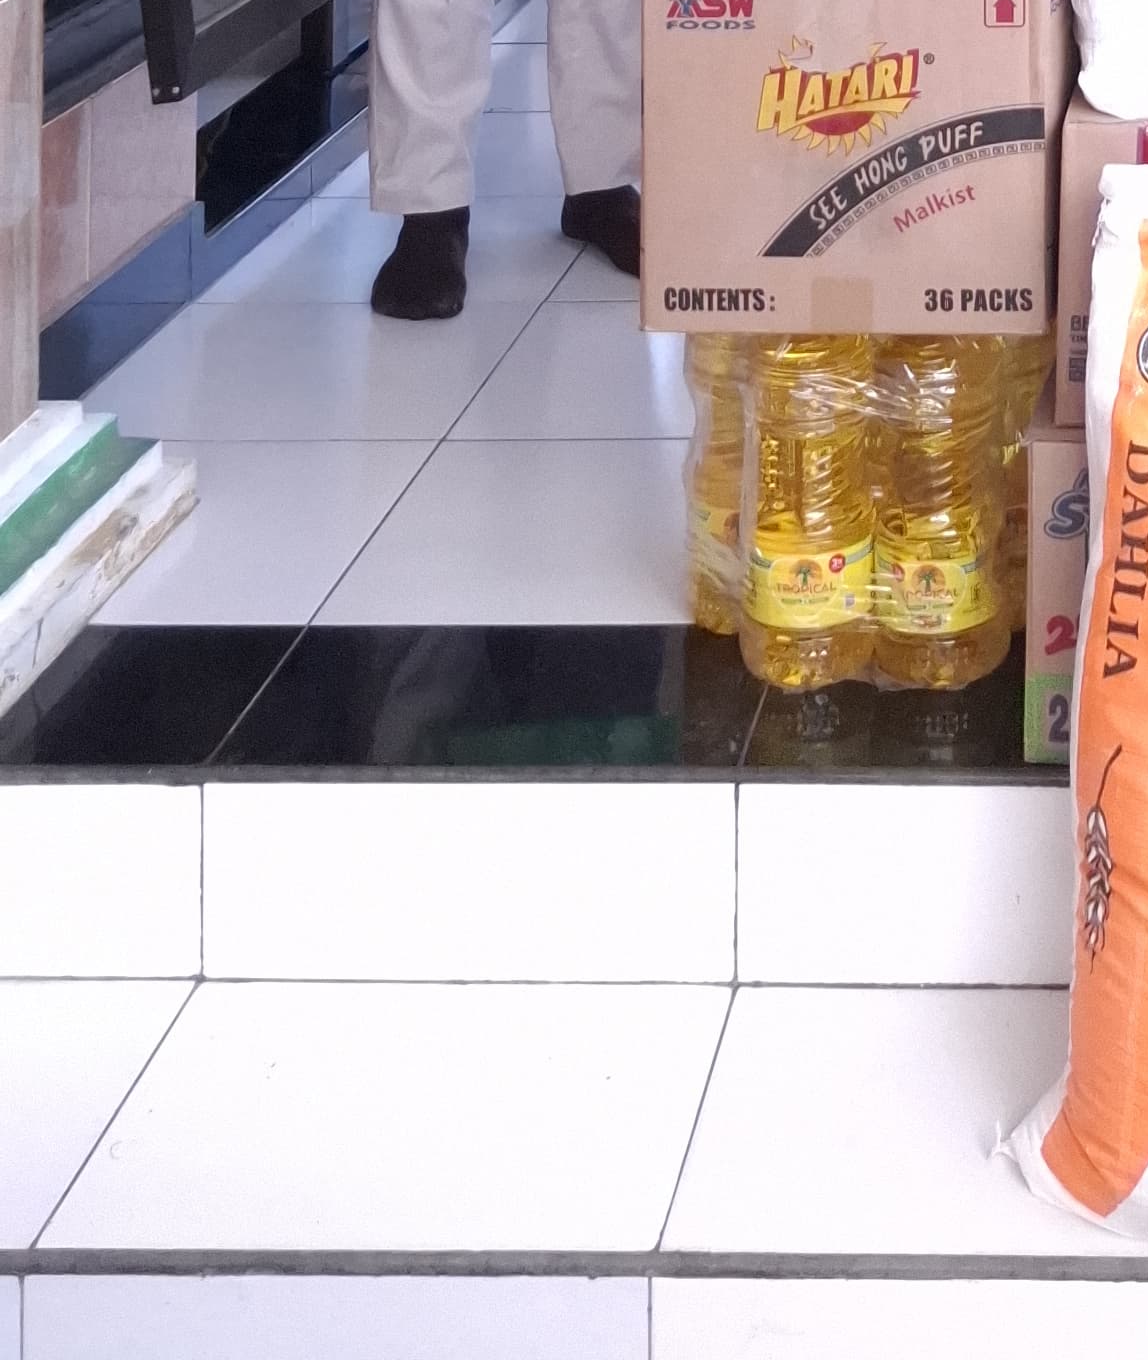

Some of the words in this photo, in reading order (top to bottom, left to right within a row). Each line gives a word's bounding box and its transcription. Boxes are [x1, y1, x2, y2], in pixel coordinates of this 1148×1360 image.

[665, 19, 756, 30] FOODS
[756, 47, 921, 137] HATARI
[808, 186, 848, 231] SEE
[853, 145, 909, 196] HONG
[917, 121, 984, 162] PUFF
[891, 184, 977, 233] Malkist
[924, 287, 953, 312] 36
[960, 287, 1033, 312] PACKS
